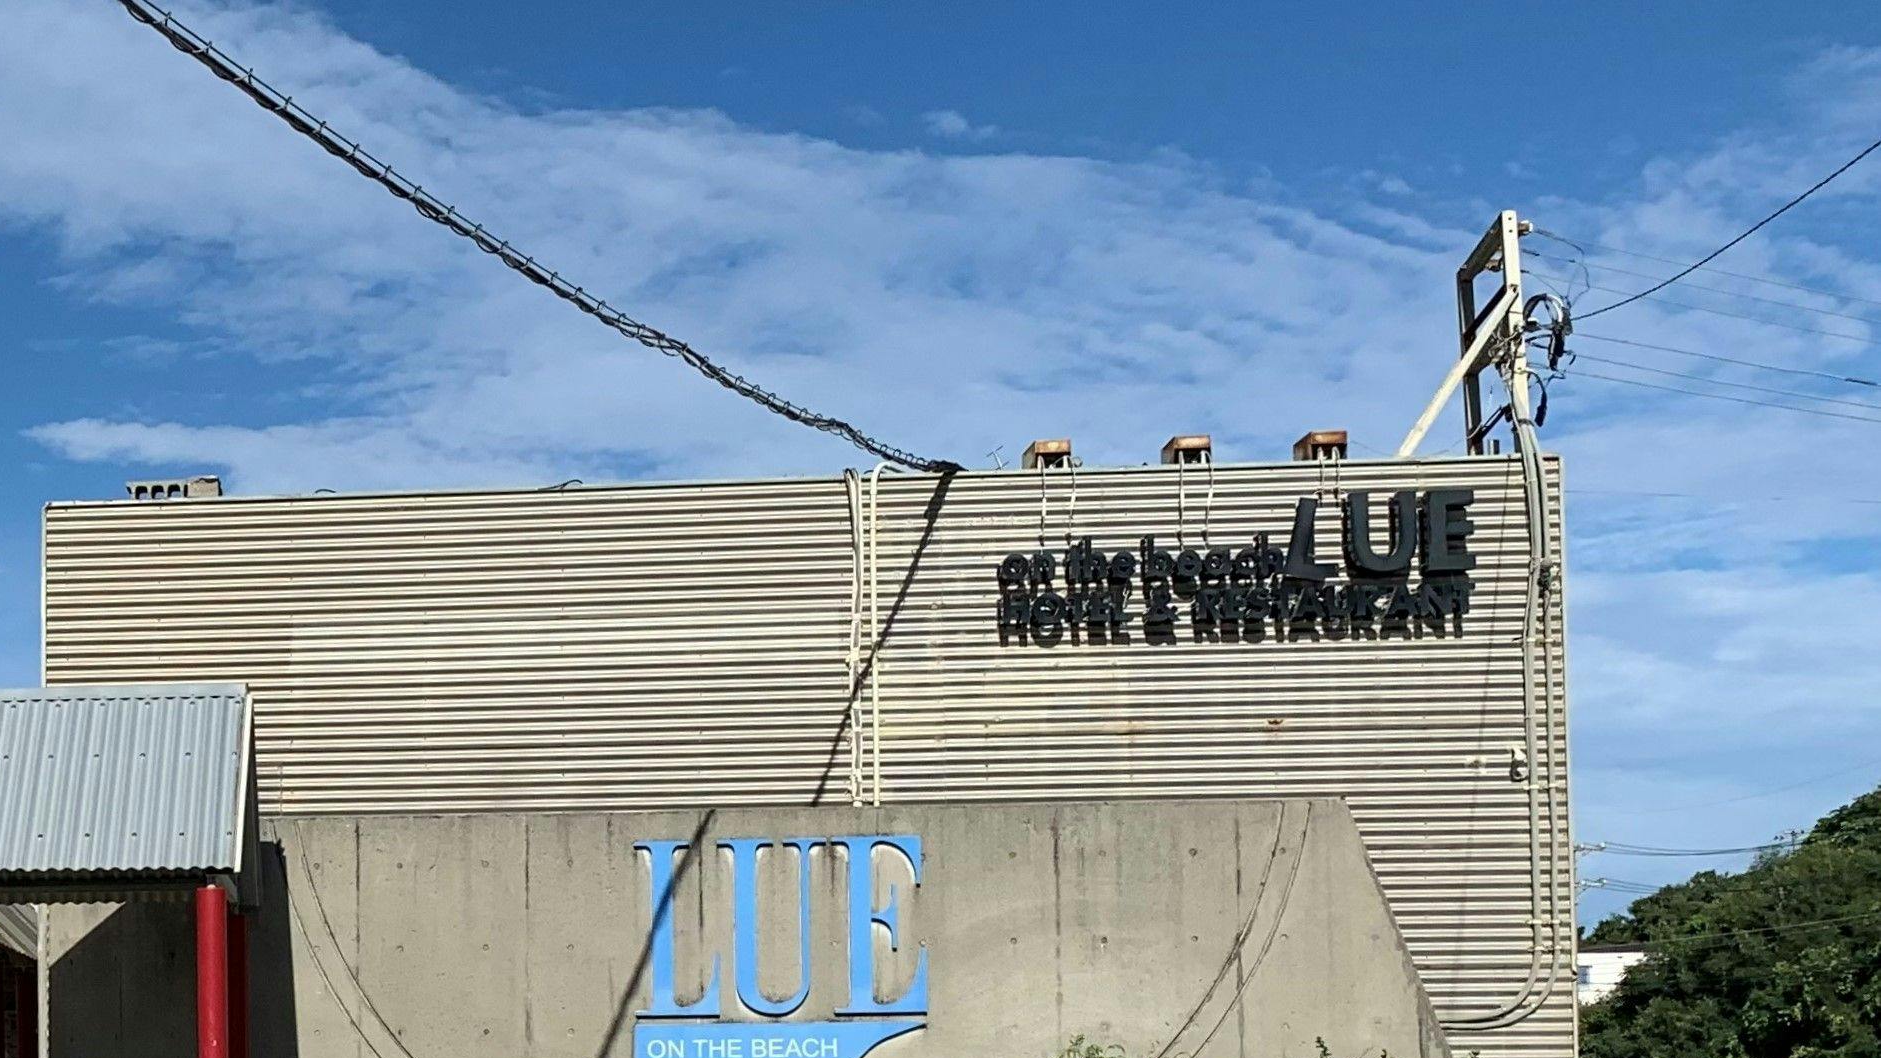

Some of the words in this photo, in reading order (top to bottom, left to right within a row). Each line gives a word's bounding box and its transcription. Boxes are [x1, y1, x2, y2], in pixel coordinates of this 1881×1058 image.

[1001, 552, 1056, 580] on
[1068, 536, 1136, 581] the
[1145, 532, 1283, 580] beach
[1283, 490, 1476, 579] LUE
[1002, 591, 1132, 624] HOTEL
[1195, 583, 1475, 621] RESTAURANT
[633, 834, 929, 1018] LUE
[692, 1038, 743, 1058] THE
[751, 1037, 838, 1058] BEACH
